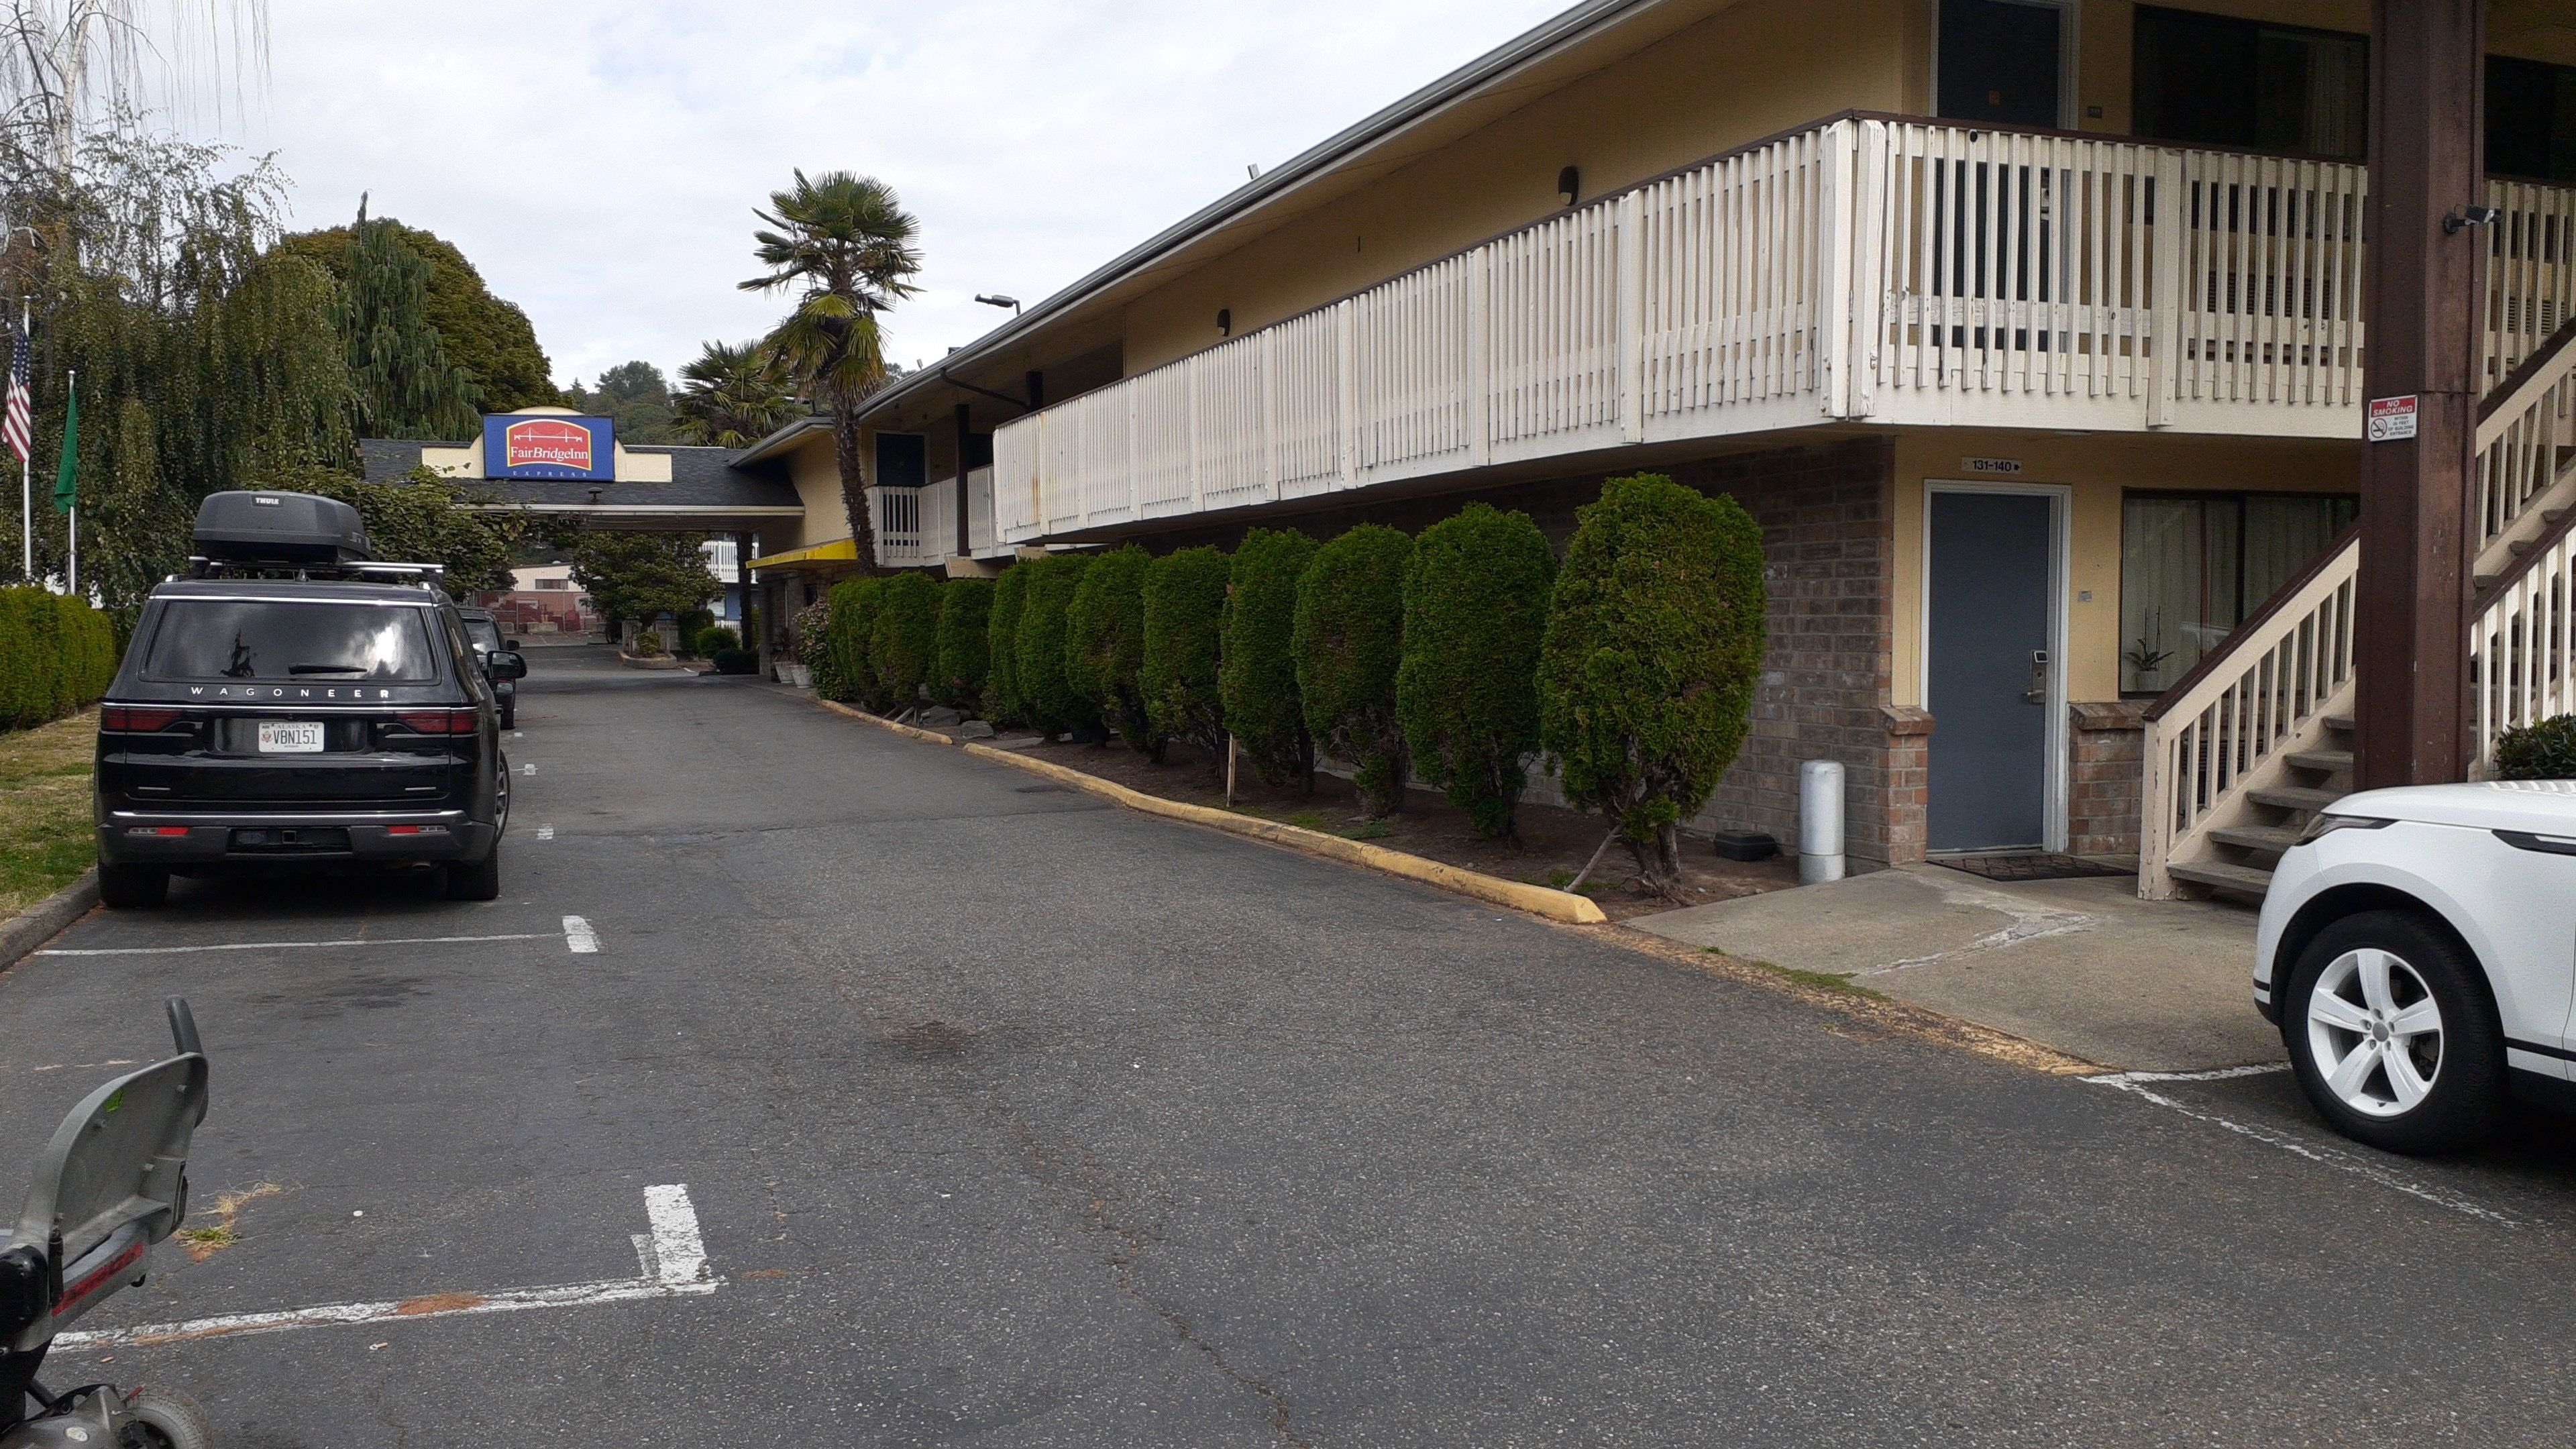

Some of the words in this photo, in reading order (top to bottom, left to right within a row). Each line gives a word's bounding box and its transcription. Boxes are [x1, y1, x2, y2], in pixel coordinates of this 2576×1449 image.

[2386, 400, 2400, 408] NO
[2373, 405, 2413, 417] SMOKING
[1973, 460, 2012, 472] 131-140
[255, 497, 279, 505] THULE
[191, 686, 389, 698] WAGONEER
[273, 729, 317, 745] VBN151
